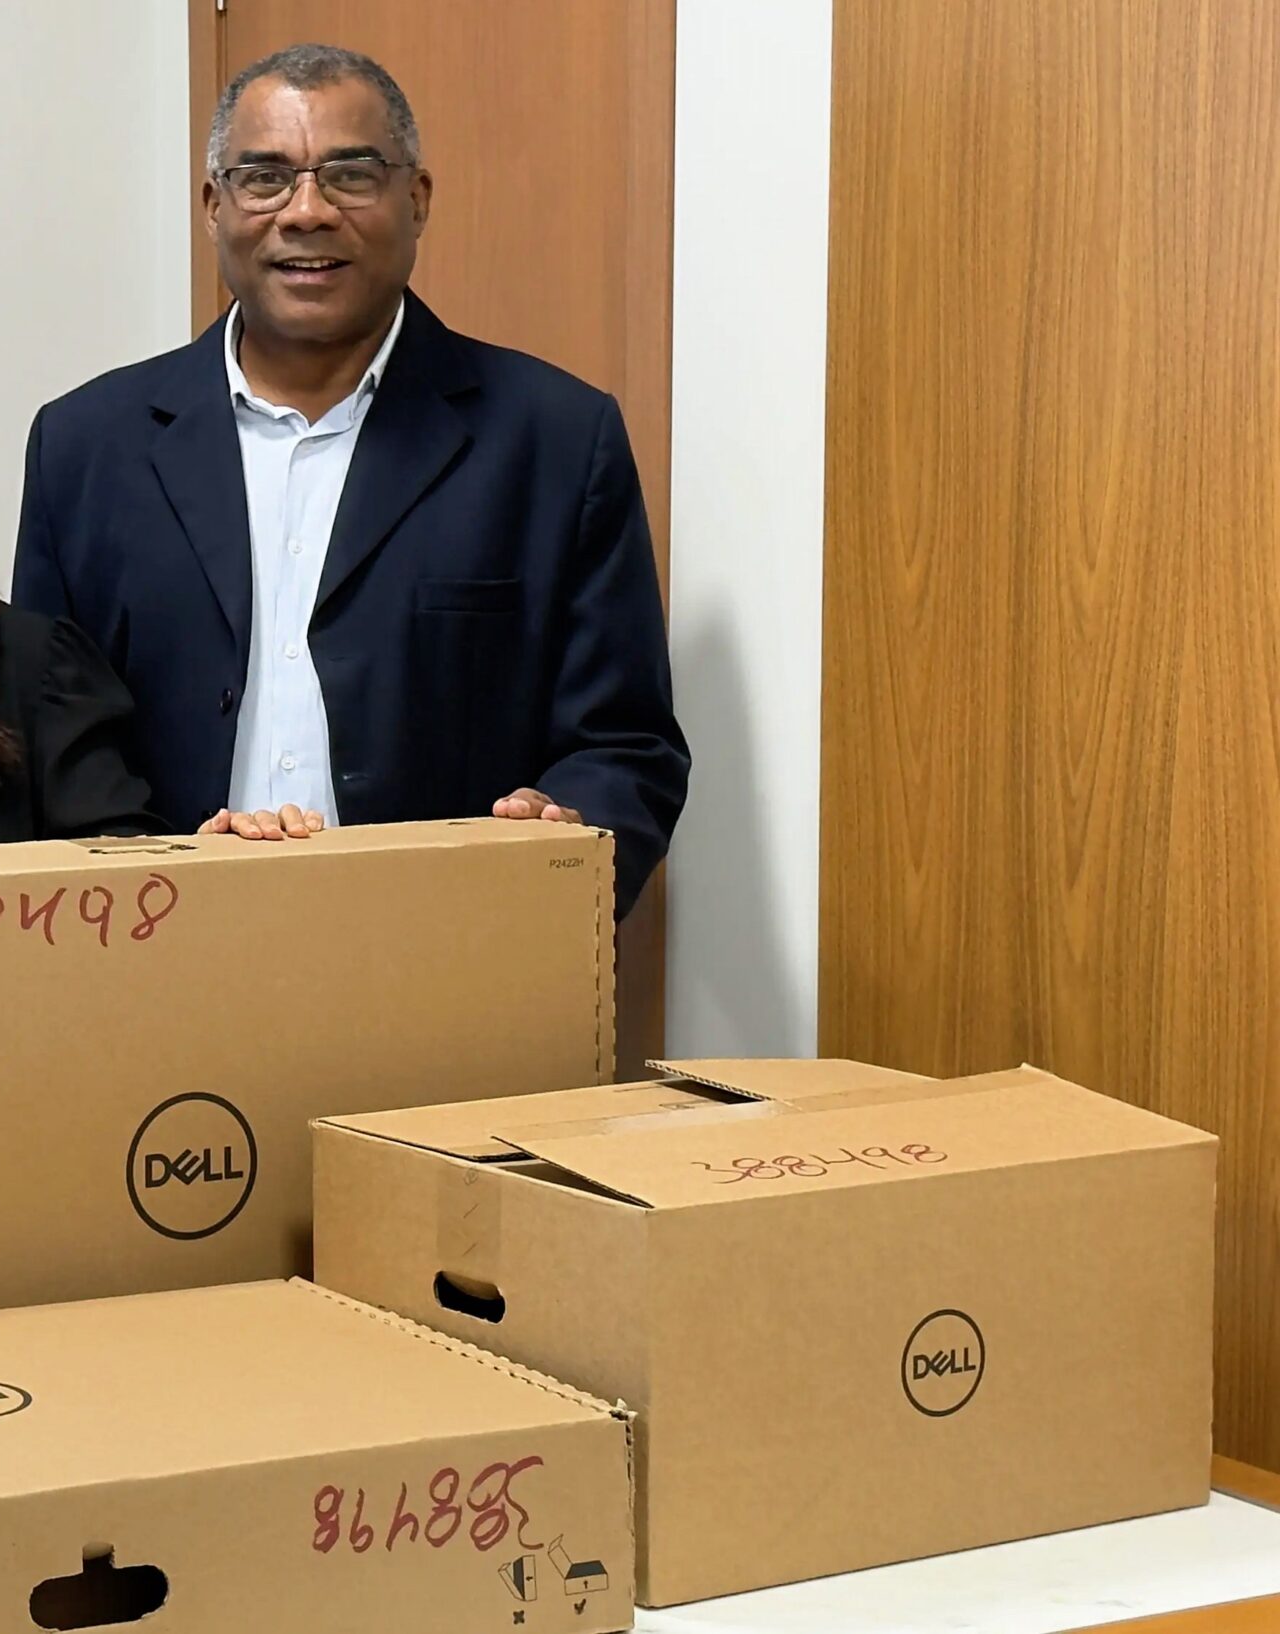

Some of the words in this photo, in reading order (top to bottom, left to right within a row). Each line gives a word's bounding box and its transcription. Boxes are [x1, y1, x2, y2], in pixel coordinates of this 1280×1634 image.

[549, 857, 584, 868] P2422H
[145, 1145, 244, 1188] DELL
[691, 1144, 948, 1184] 388498
[913, 1347, 976, 1380] DELL
